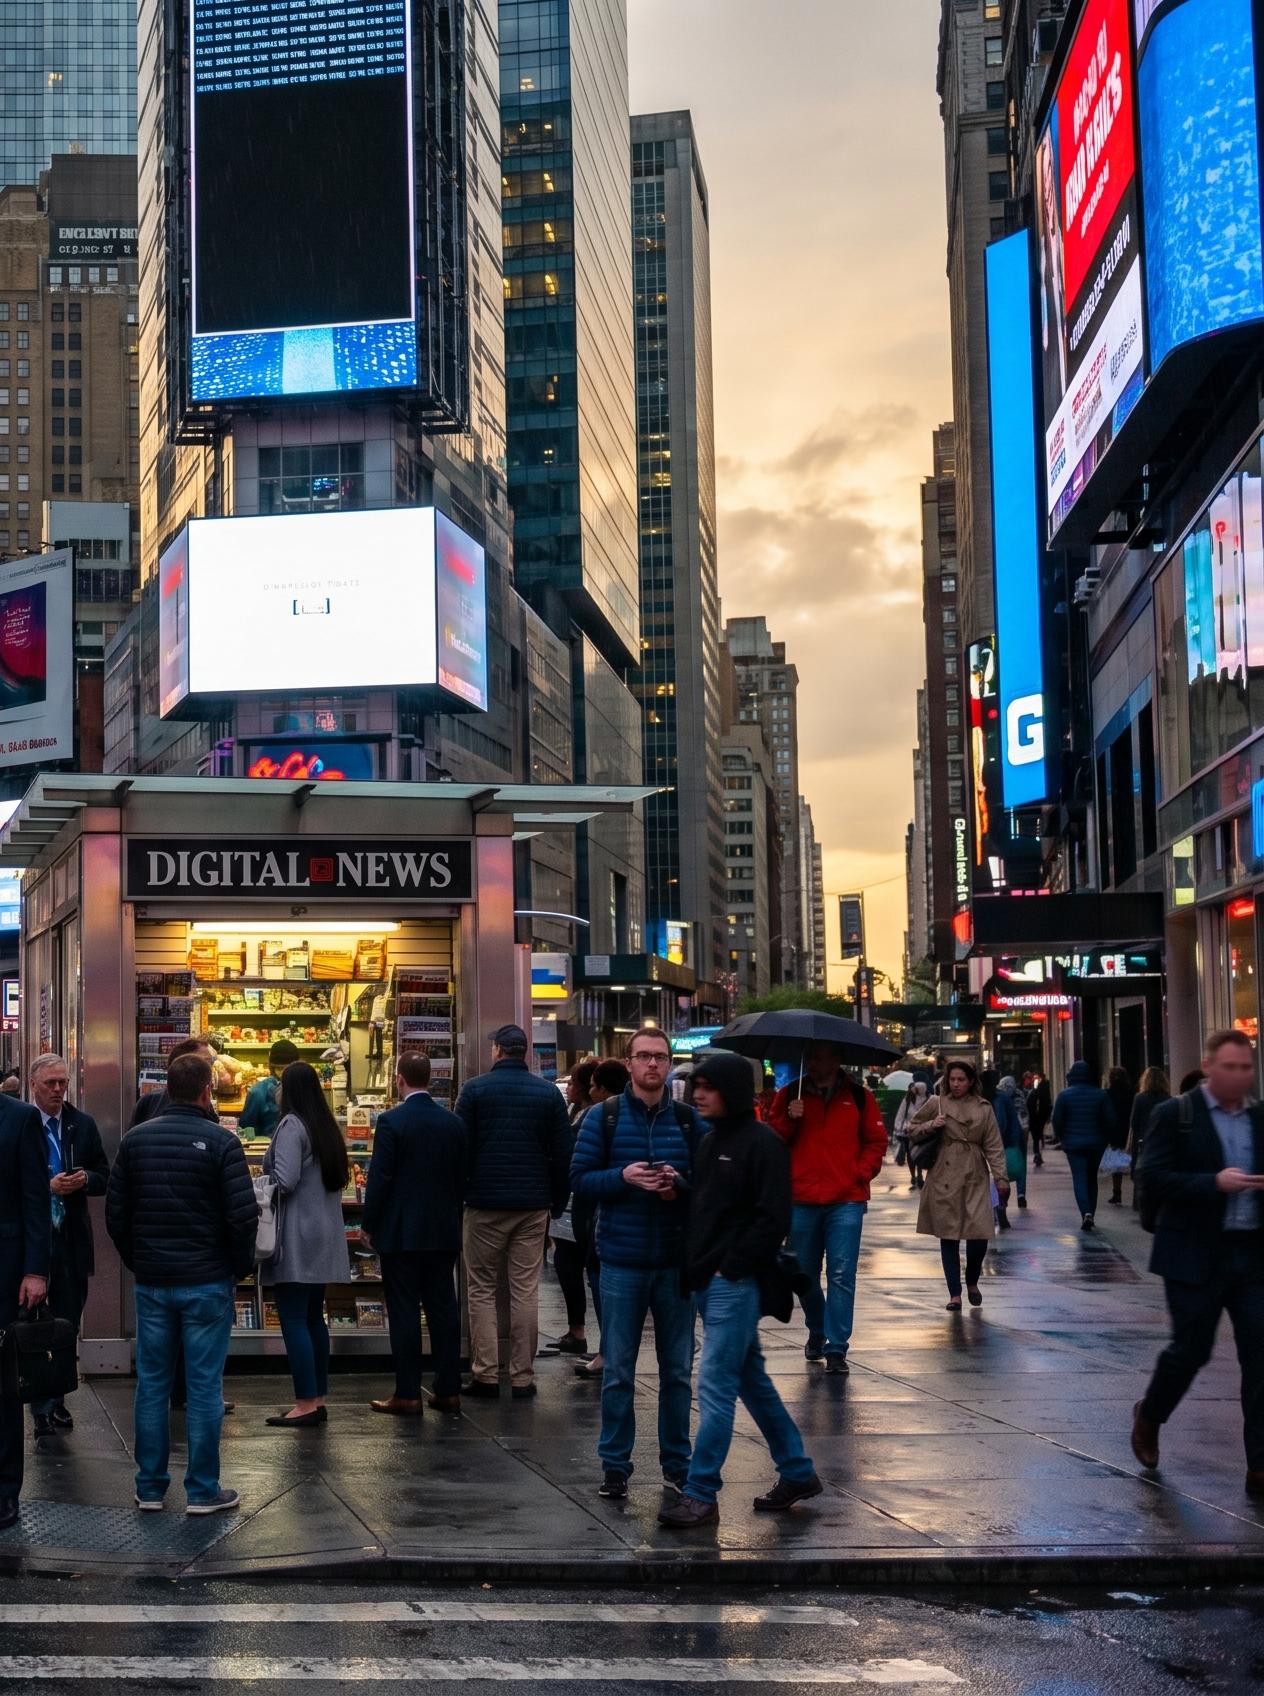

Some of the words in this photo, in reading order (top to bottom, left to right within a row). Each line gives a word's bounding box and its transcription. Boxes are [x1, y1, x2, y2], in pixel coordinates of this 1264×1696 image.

[1007, 693, 1044, 766] G
[146, 850, 310, 887] DIGITAL
[336, 851, 452, 888] NEWS
